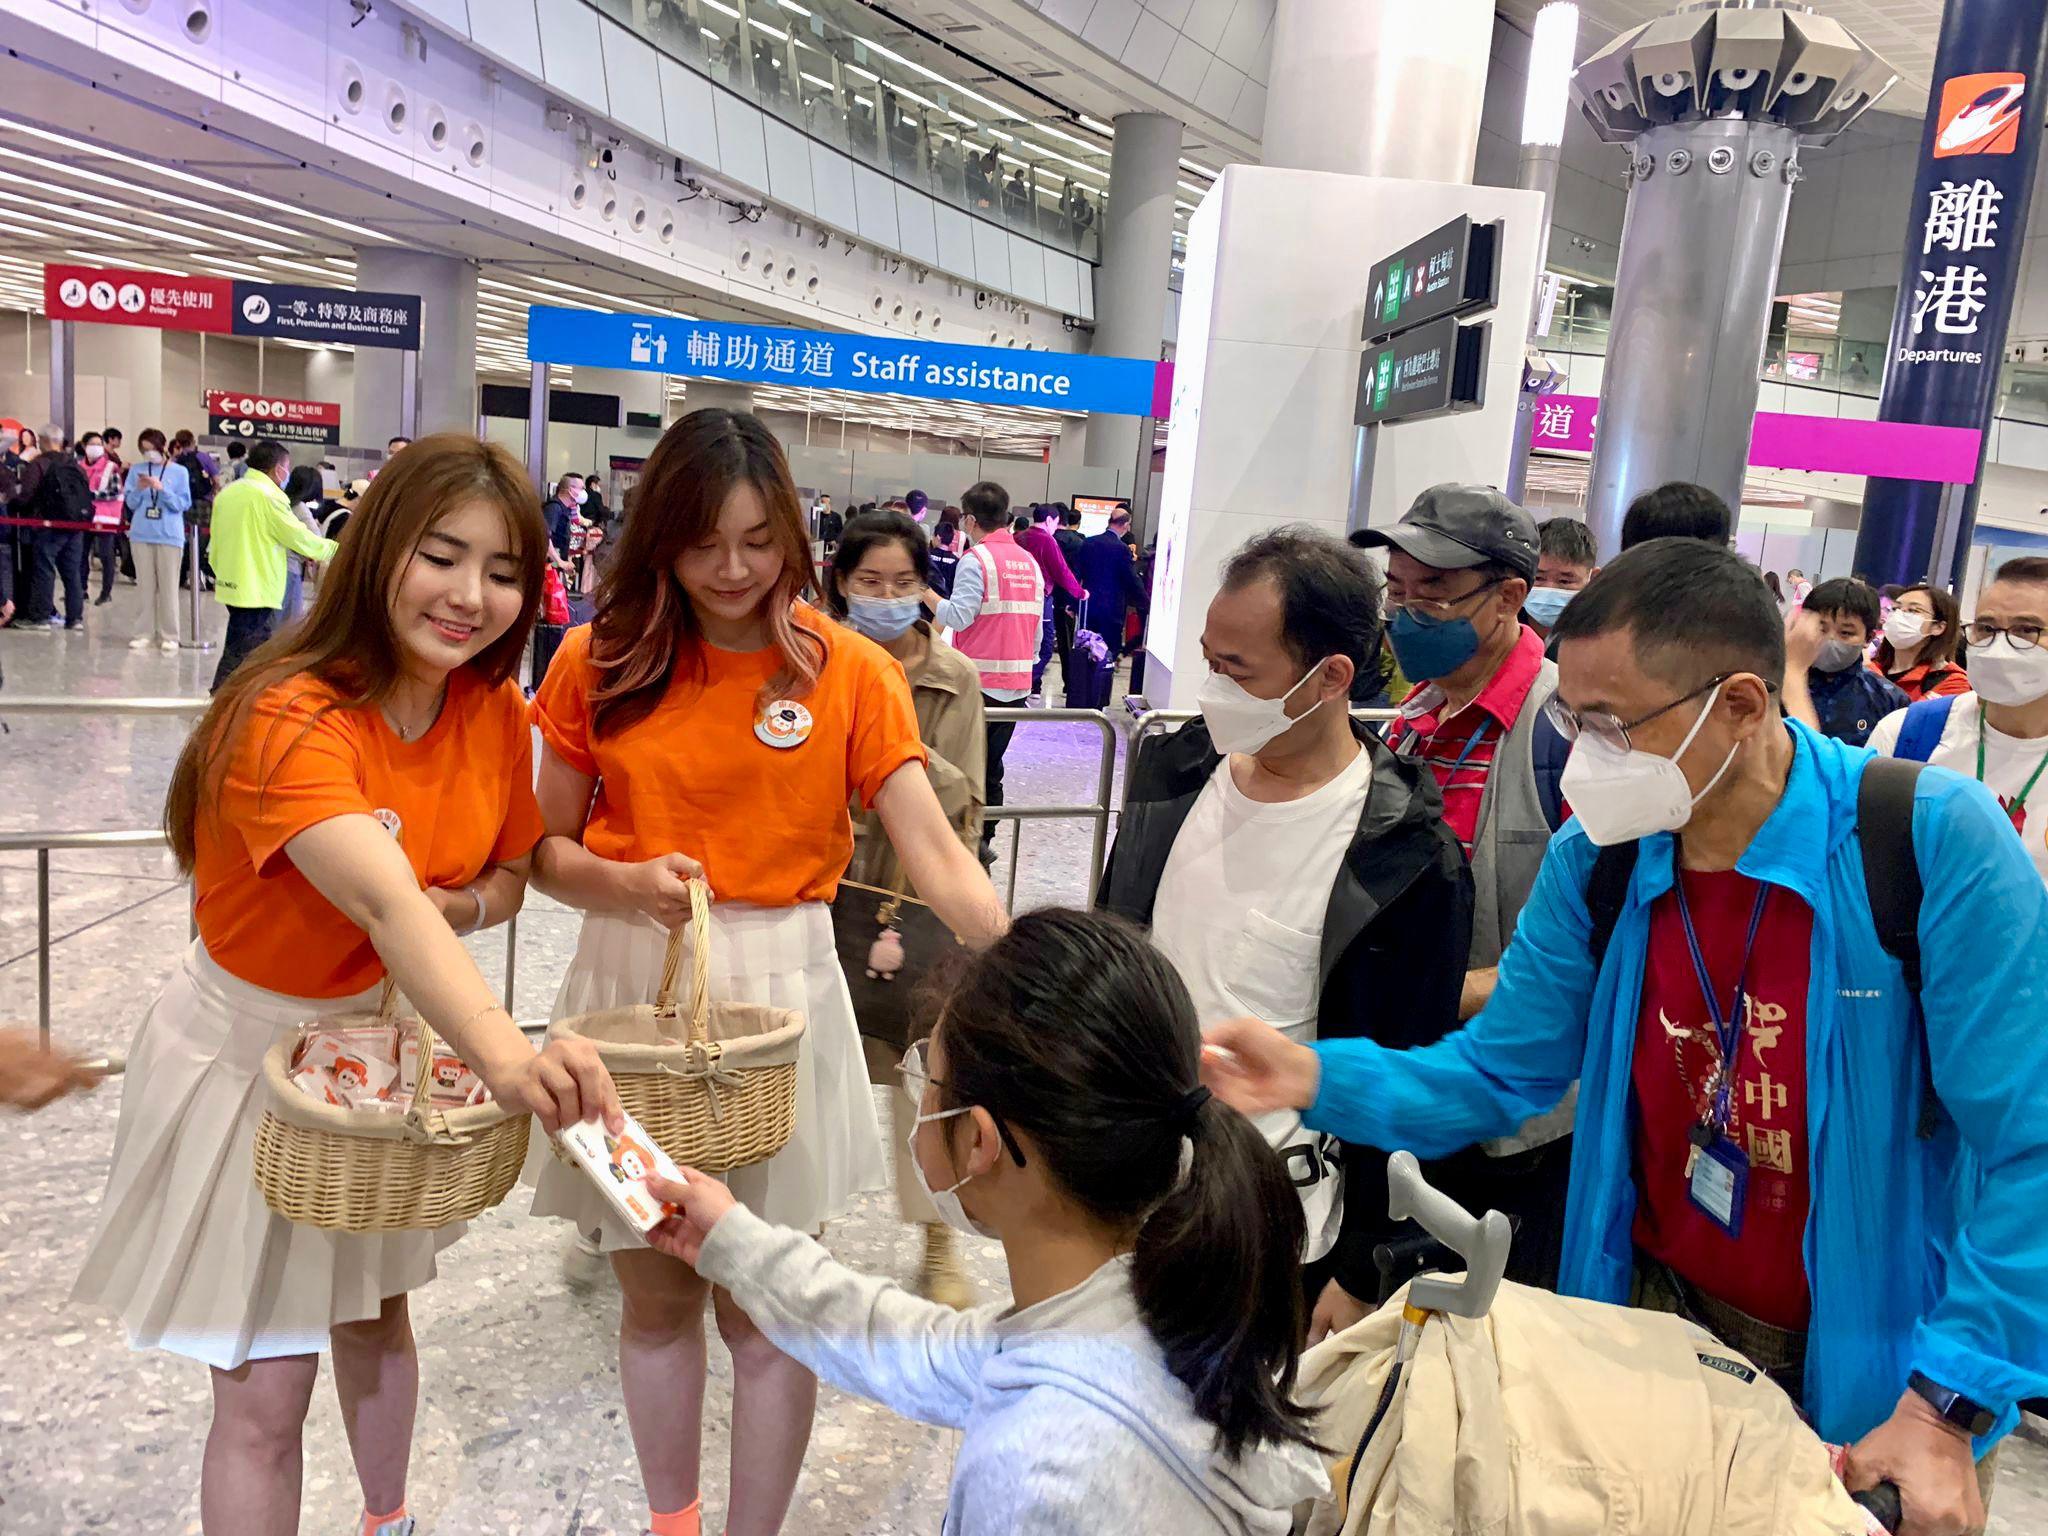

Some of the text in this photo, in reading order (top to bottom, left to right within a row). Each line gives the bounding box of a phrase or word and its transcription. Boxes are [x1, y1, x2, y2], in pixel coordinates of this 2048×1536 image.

[1912, 178, 2003, 334] 離港
[1388, 269, 1400, 302] 出
[1403, 274, 1411, 298] A
[150, 287, 213, 309] 優先使用
[1386, 301, 1396, 314] EXIT
[149, 305, 177, 317] Priority
[276, 316, 400, 334] First, Premium and Business Class
[686, 329, 834, 378] 輔助通道
[1898, 348, 1982, 365] Departures
[851, 350, 1071, 395] Staff assistance
[1378, 359, 1390, 391] 出
[1394, 366, 1401, 389] K
